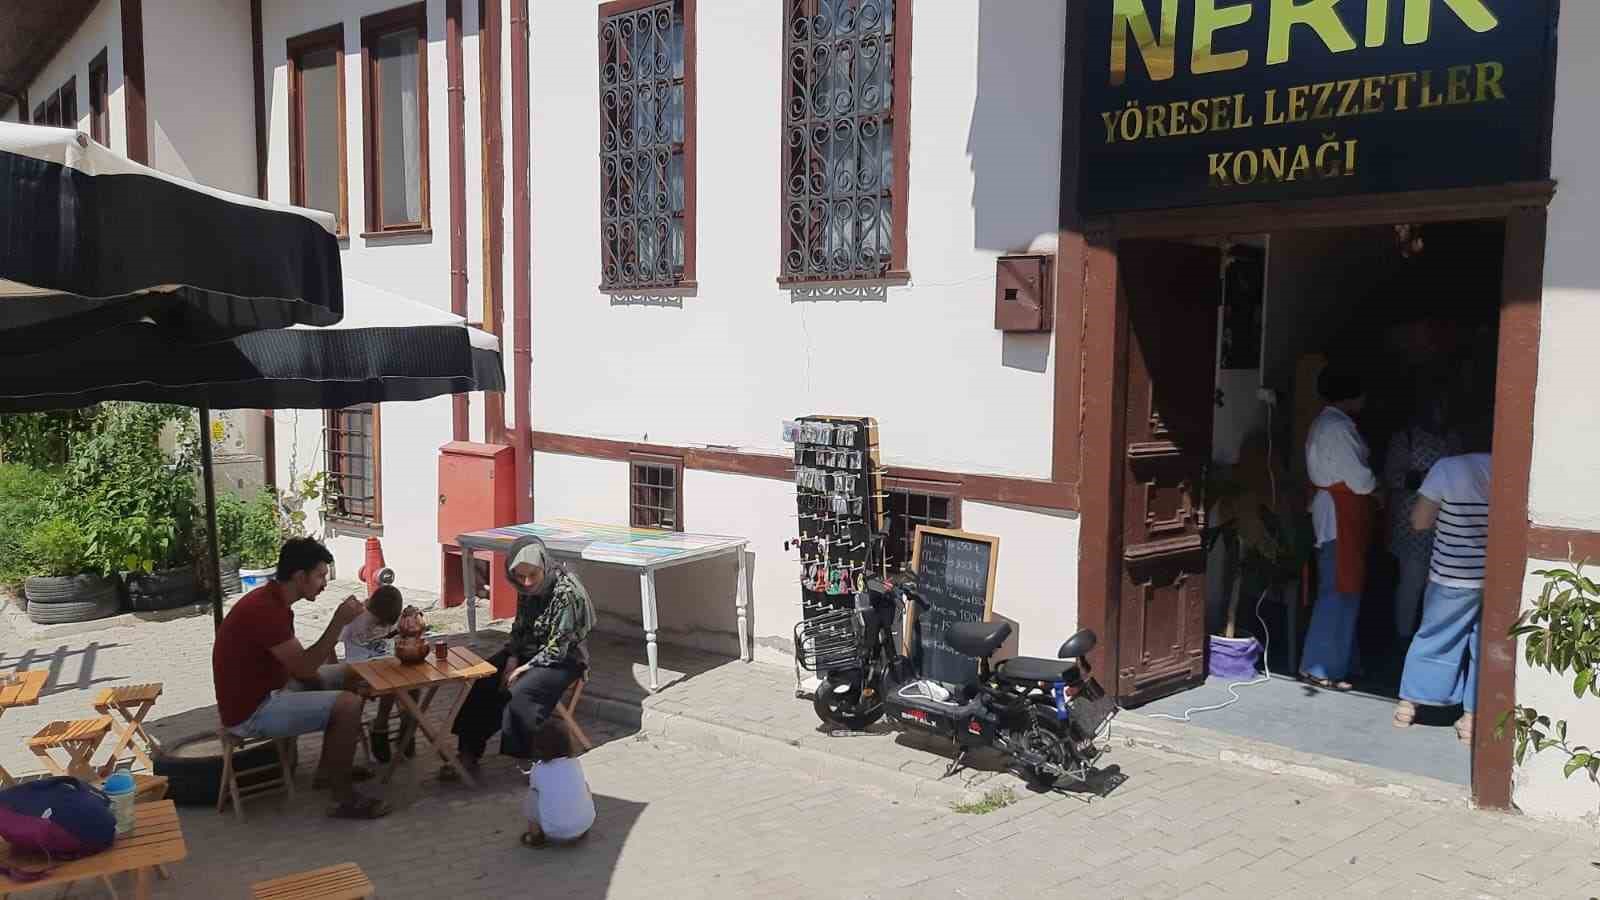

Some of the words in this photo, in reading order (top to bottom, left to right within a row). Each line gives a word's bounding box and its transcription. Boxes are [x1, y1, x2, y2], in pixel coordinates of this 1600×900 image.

[1101, 94, 1254, 144] YÖRESEL
[1263, 61, 1506, 127] LEZZETLER
[1207, 130, 1359, 187] KONAĞI
